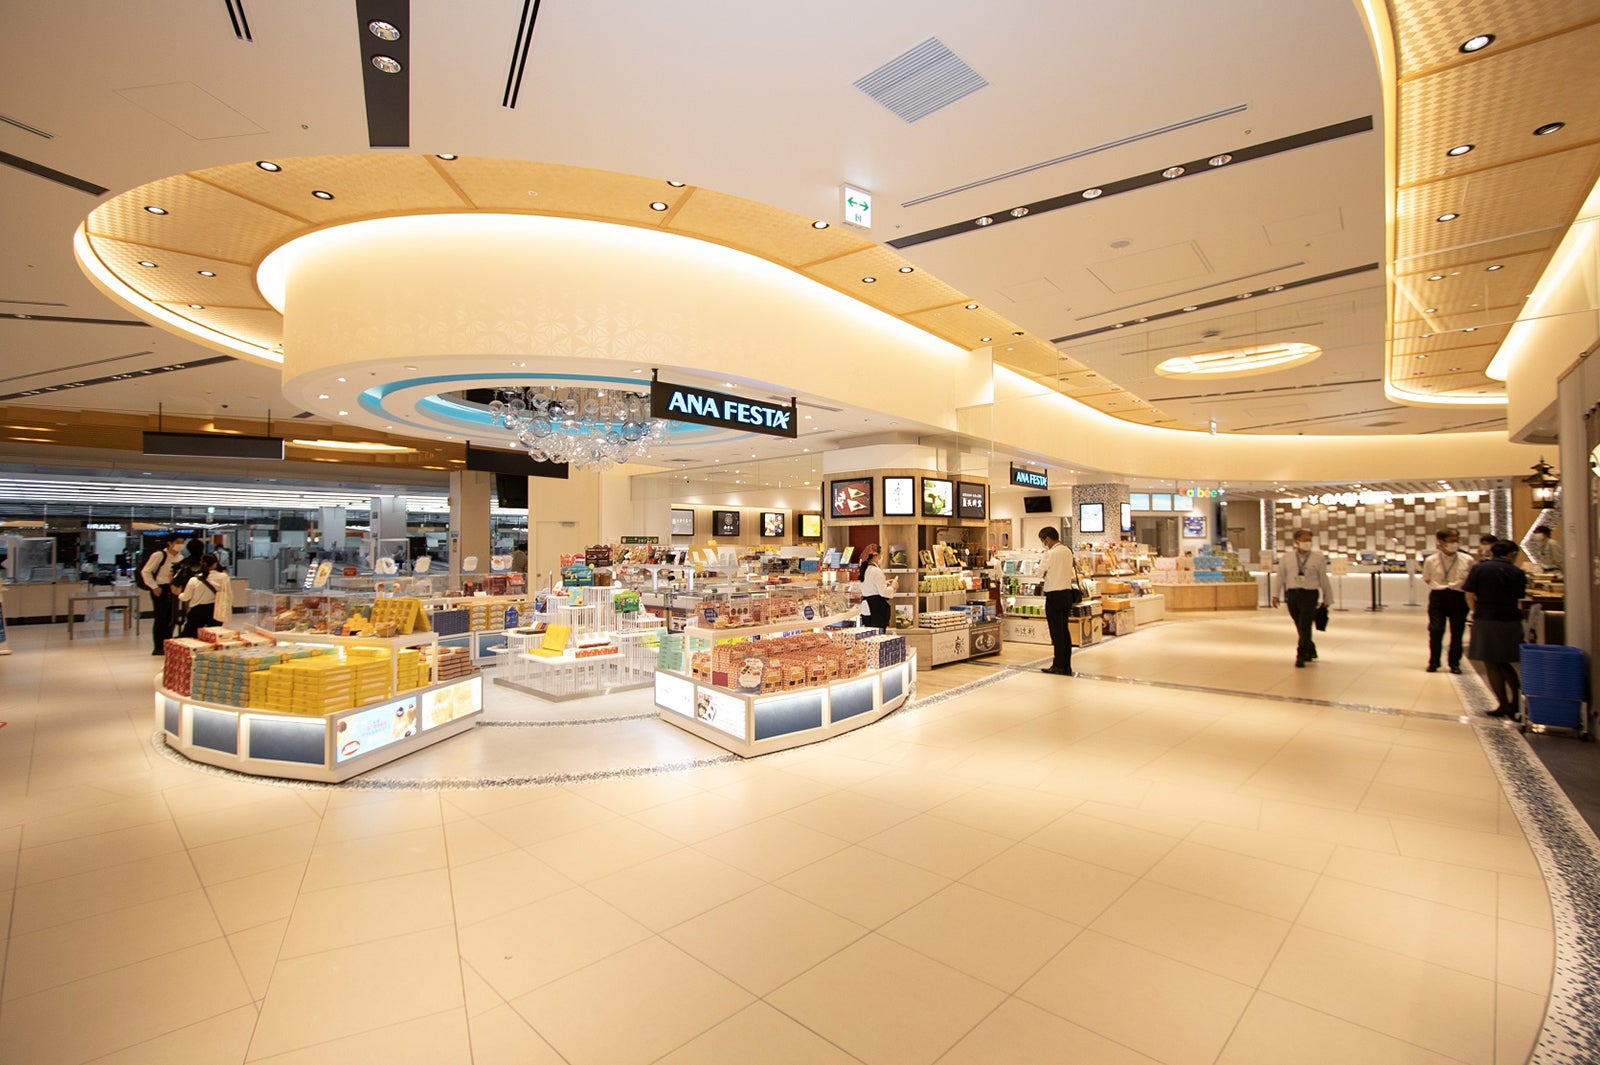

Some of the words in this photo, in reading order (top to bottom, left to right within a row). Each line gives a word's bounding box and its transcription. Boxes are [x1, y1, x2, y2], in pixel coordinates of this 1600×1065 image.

[669, 391, 720, 418] ANA
[724, 401, 791, 430] FESTA
[1016, 471, 1029, 483] ANA
[1030, 474, 1047, 487] FESTA
